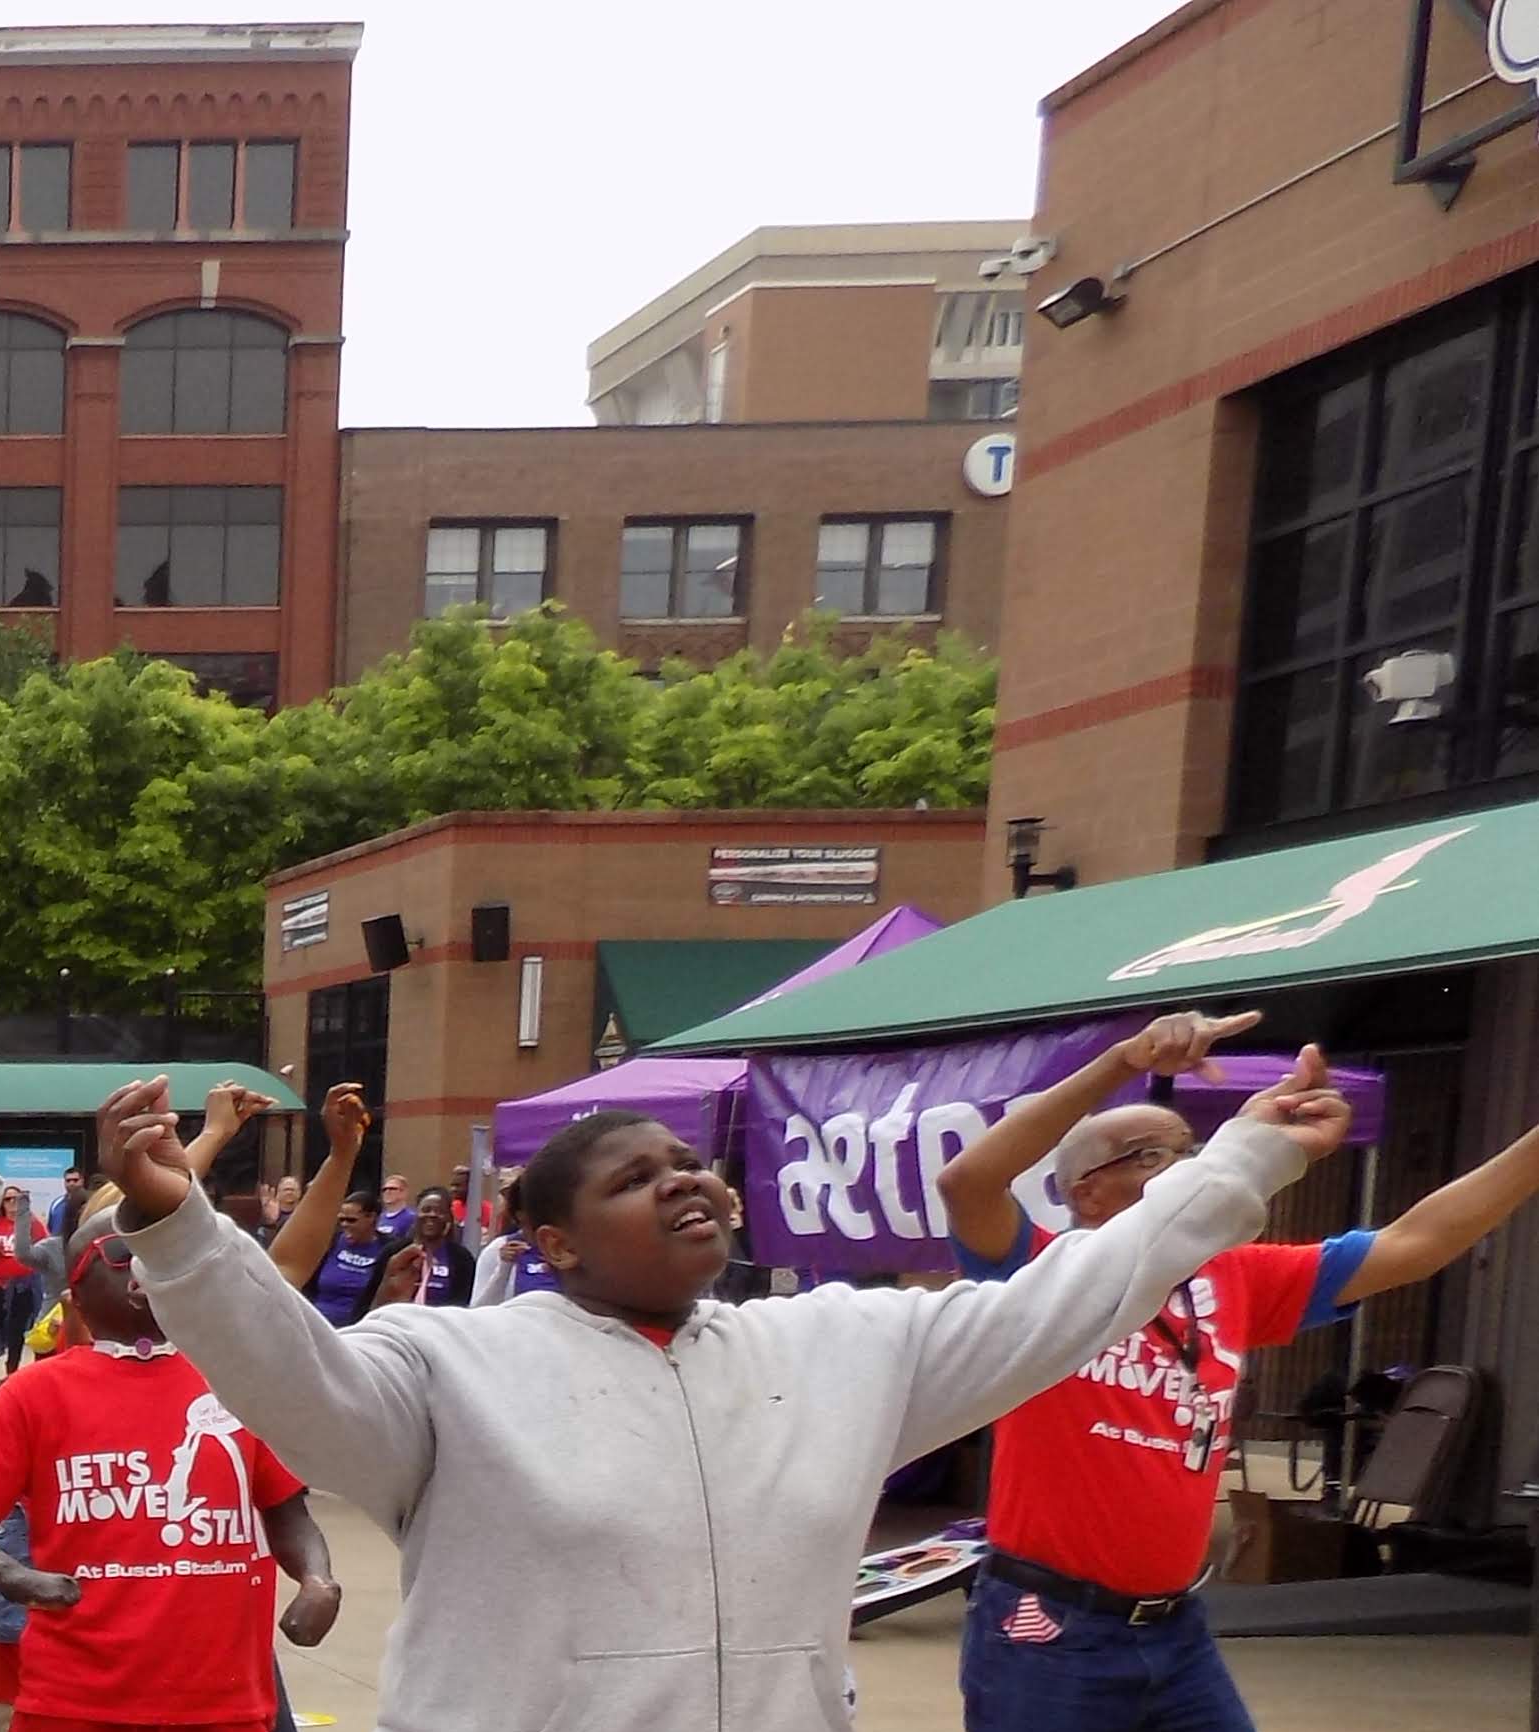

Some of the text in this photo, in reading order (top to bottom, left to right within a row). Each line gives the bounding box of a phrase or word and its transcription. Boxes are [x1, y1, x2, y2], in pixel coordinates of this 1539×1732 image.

[986, 445, 1012, 483] T
[55, 1450, 151, 1492] LET'S
[190, 1508, 244, 1546] STL
[74, 1559, 247, 1580] At Busch Stadium
